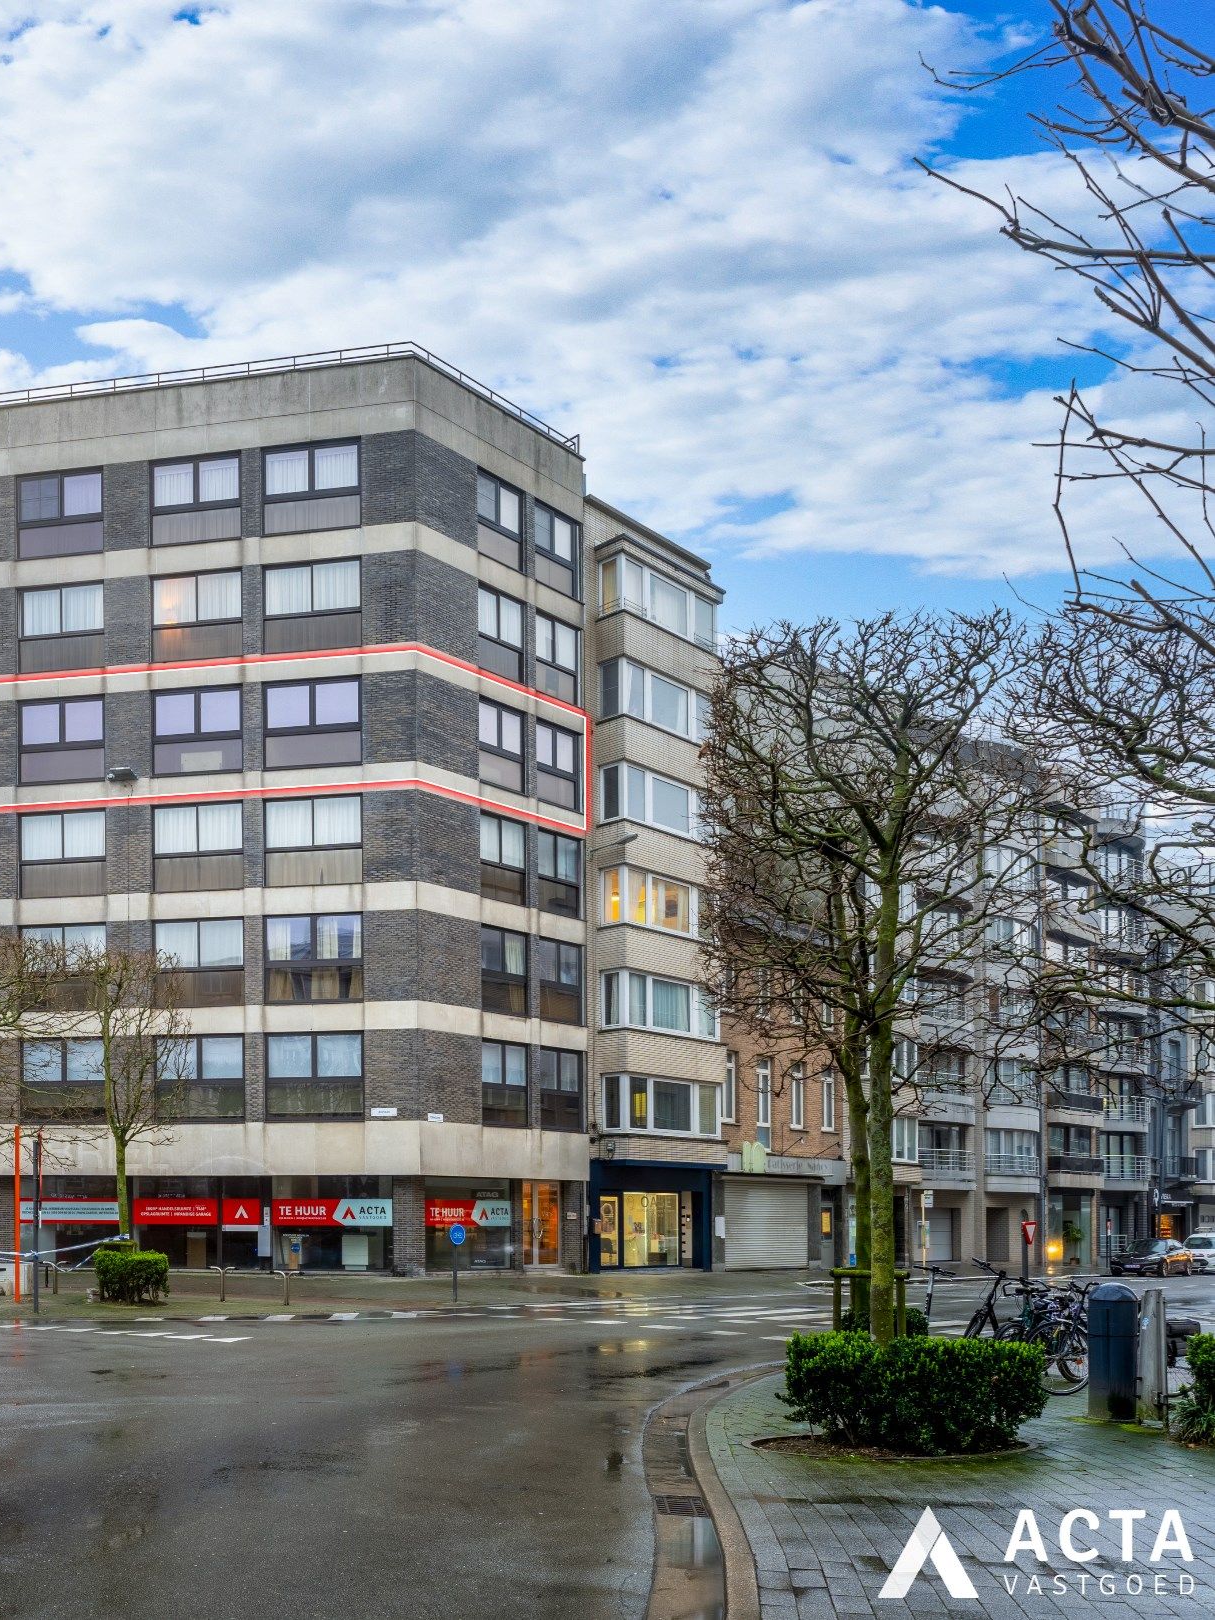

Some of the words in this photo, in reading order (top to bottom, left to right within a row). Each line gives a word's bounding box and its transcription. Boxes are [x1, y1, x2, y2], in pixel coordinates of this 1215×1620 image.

[279, 1206, 292, 1216] TE
[295, 1206, 327, 1216] HUUR
[359, 1206, 386, 1215] ACTA
[430, 1207, 440, 1217] TE
[441, 1207, 464, 1217] HUUR
[490, 1207, 509, 1216] ACTA
